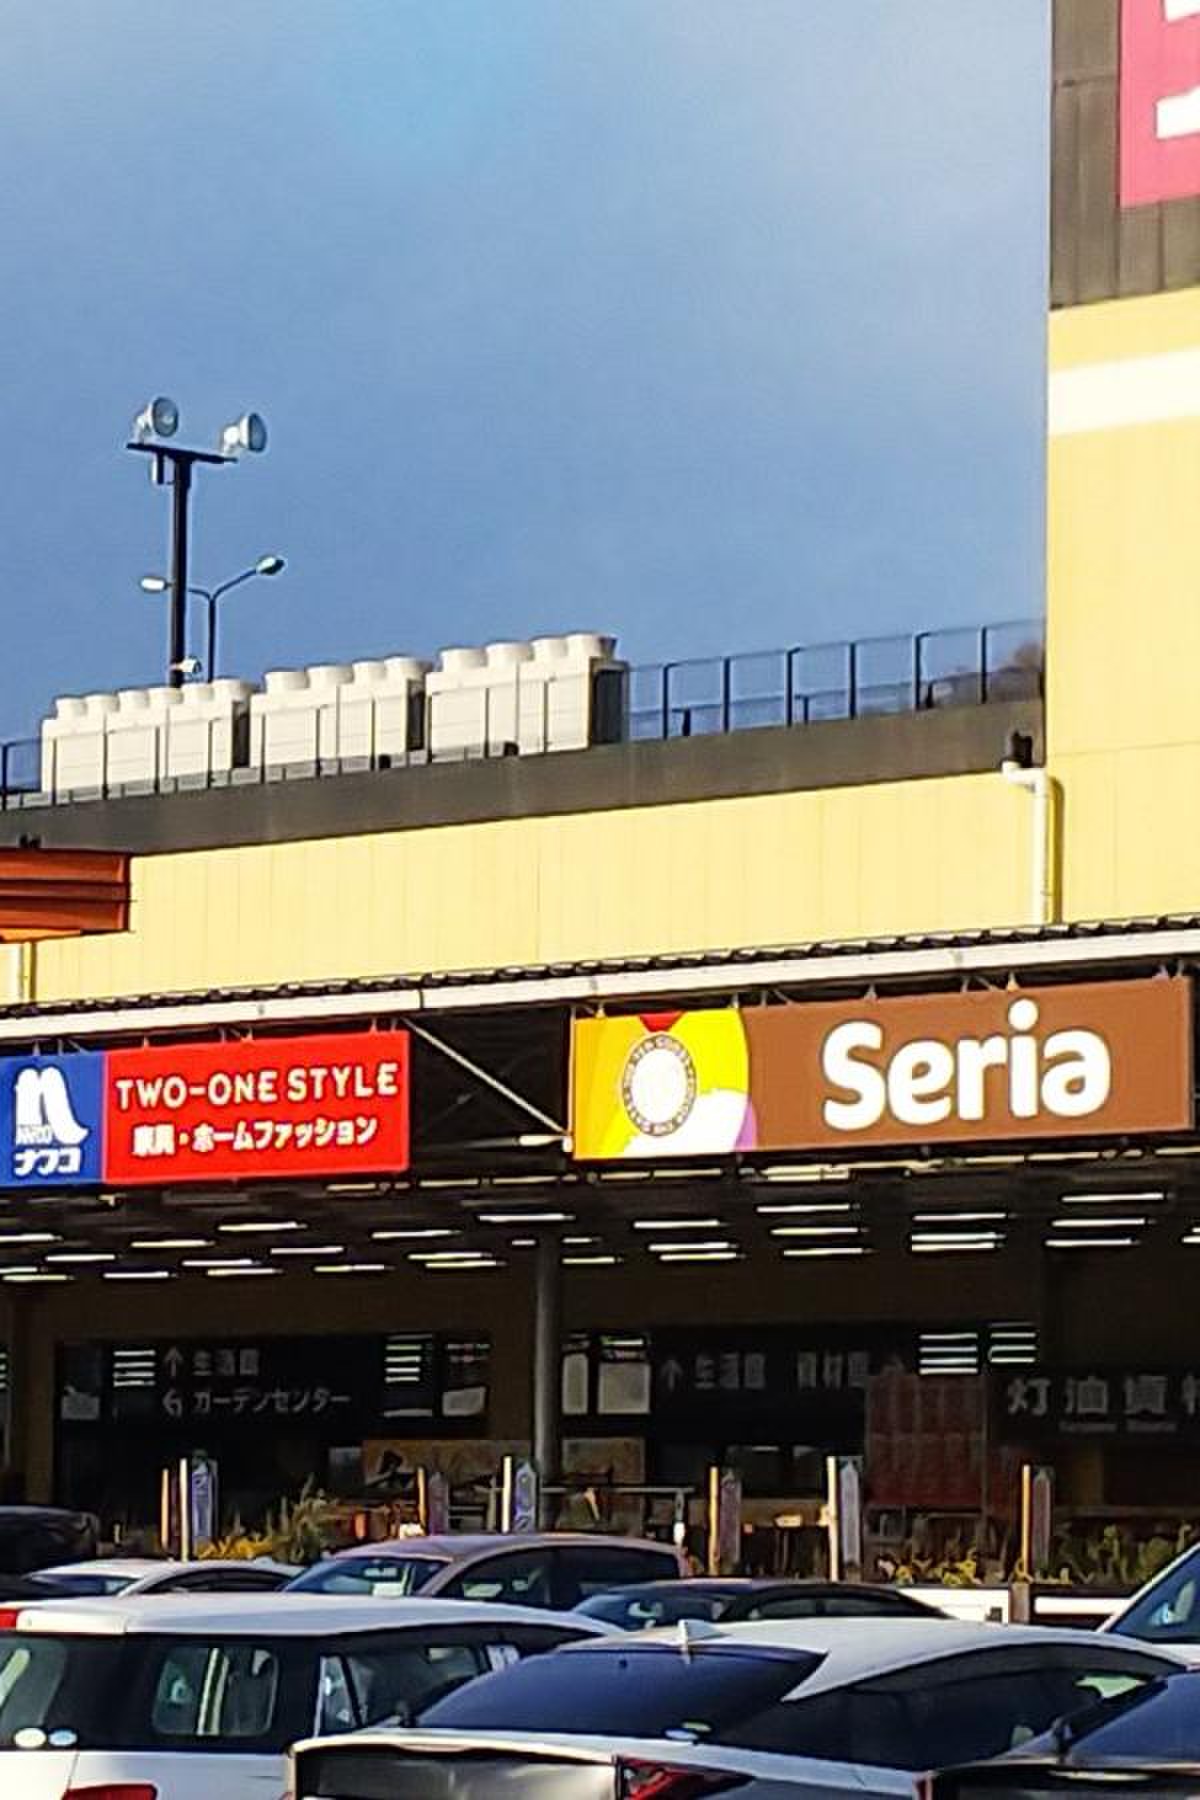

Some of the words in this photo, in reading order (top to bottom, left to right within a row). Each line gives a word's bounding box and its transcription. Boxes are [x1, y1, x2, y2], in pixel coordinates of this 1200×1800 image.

[822, 997, 1112, 1132] Seria
[115, 1070, 278, 1110] TWO-ONE
[287, 1062, 399, 1102] STYLE
[13, 1146, 82, 1177] ナフコ
[192, 1384, 353, 1416] ガーデンセンター
